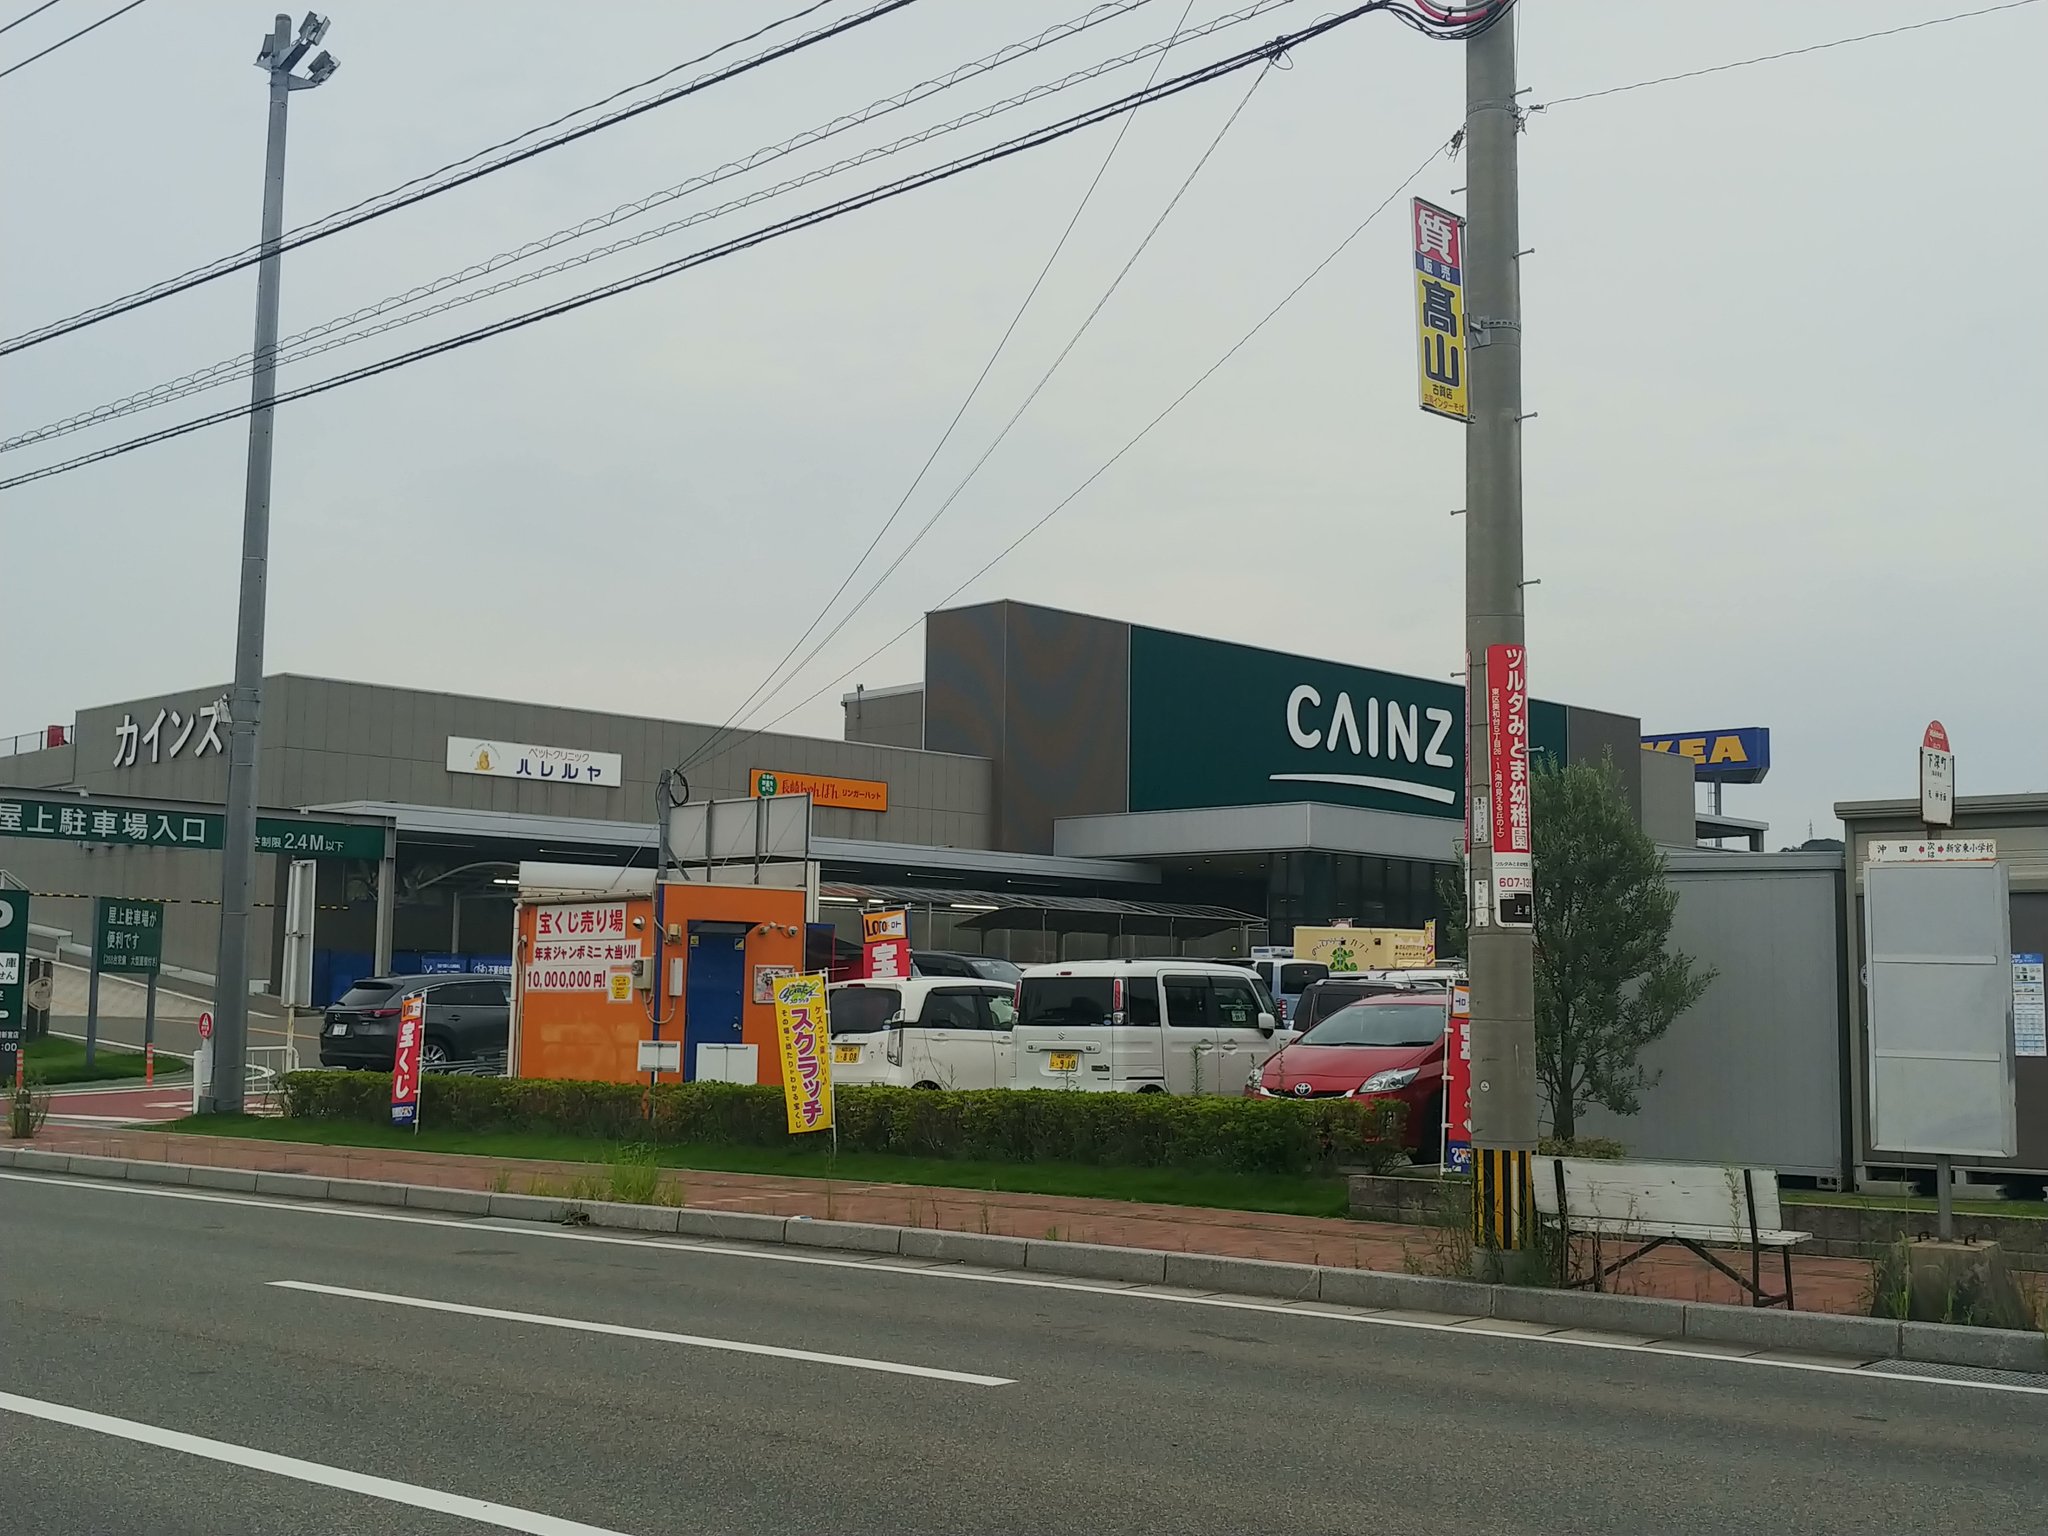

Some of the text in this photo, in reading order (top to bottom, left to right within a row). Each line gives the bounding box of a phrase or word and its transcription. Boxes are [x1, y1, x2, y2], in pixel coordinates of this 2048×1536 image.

[1418, 208, 1453, 264] 質
[1423, 257, 1451, 281] 販売
[1287, 685, 1454, 768] CAINZ
[529, 748, 590, 763] ペットクリニック
[1506, 648, 1529, 850] ツルタみとま幼稚園
[516, 758, 602, 782] ハレルヤ
[0, 803, 206, 843] 屋上駐車場入口
[108, 906, 157, 928] 屋上駐車場が
[539, 909, 624, 935] 宝くじ売り場
[107, 930, 139, 950] 便利です
[535, 946, 602, 961] 年末ジャンボミニ
[396, 1021, 415, 1099] 宝くじ
[791, 1008, 823, 1127] スクラッチ
